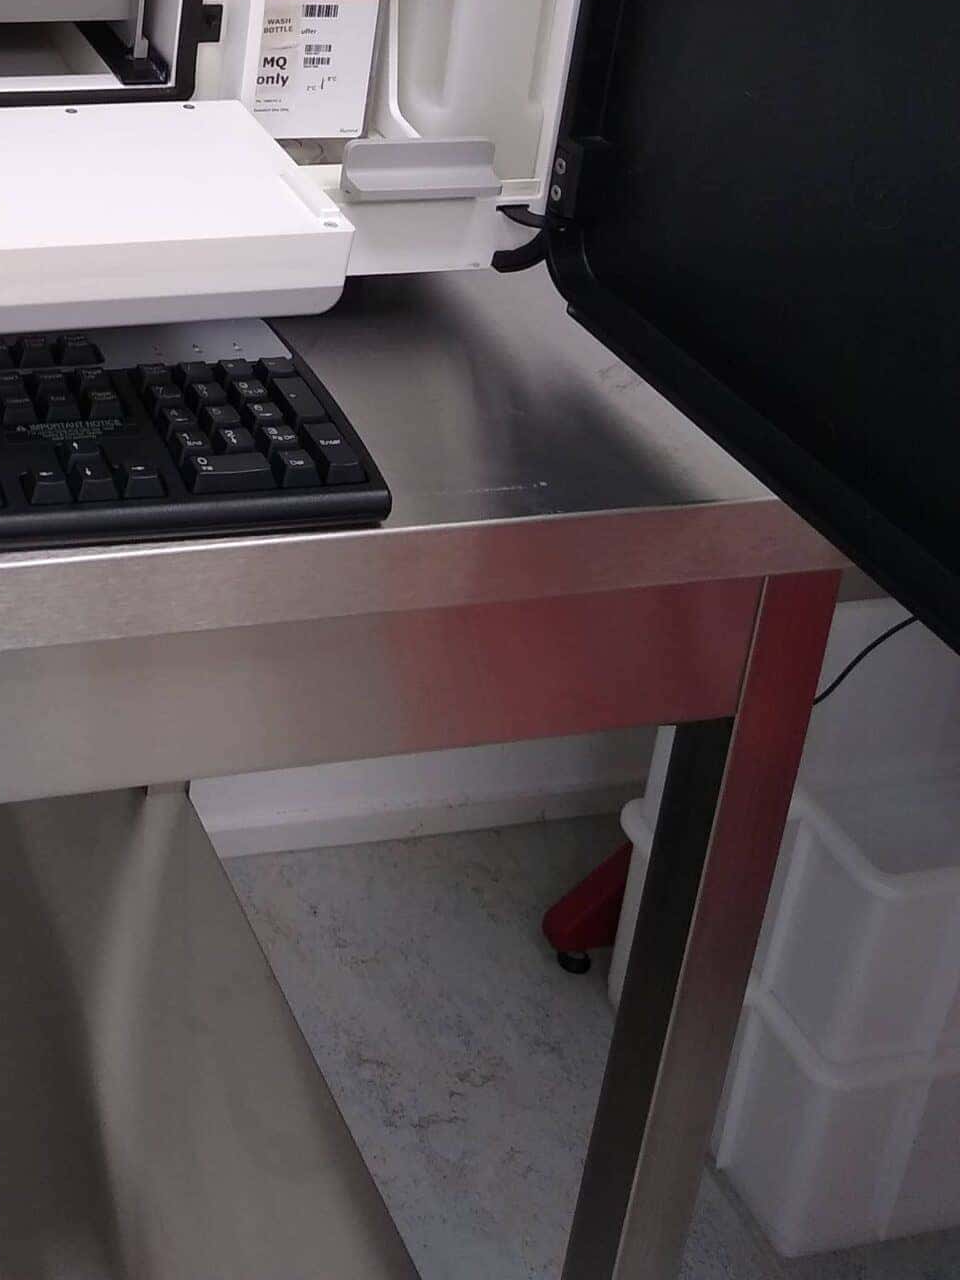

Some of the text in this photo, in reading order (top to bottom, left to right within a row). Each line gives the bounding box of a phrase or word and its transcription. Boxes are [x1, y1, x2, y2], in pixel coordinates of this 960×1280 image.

[266, 17, 292, 25] WASH
[263, 25, 294, 34] BOTTLE
[262, 55, 288, 71] MQ
[256, 72, 289, 87] only
